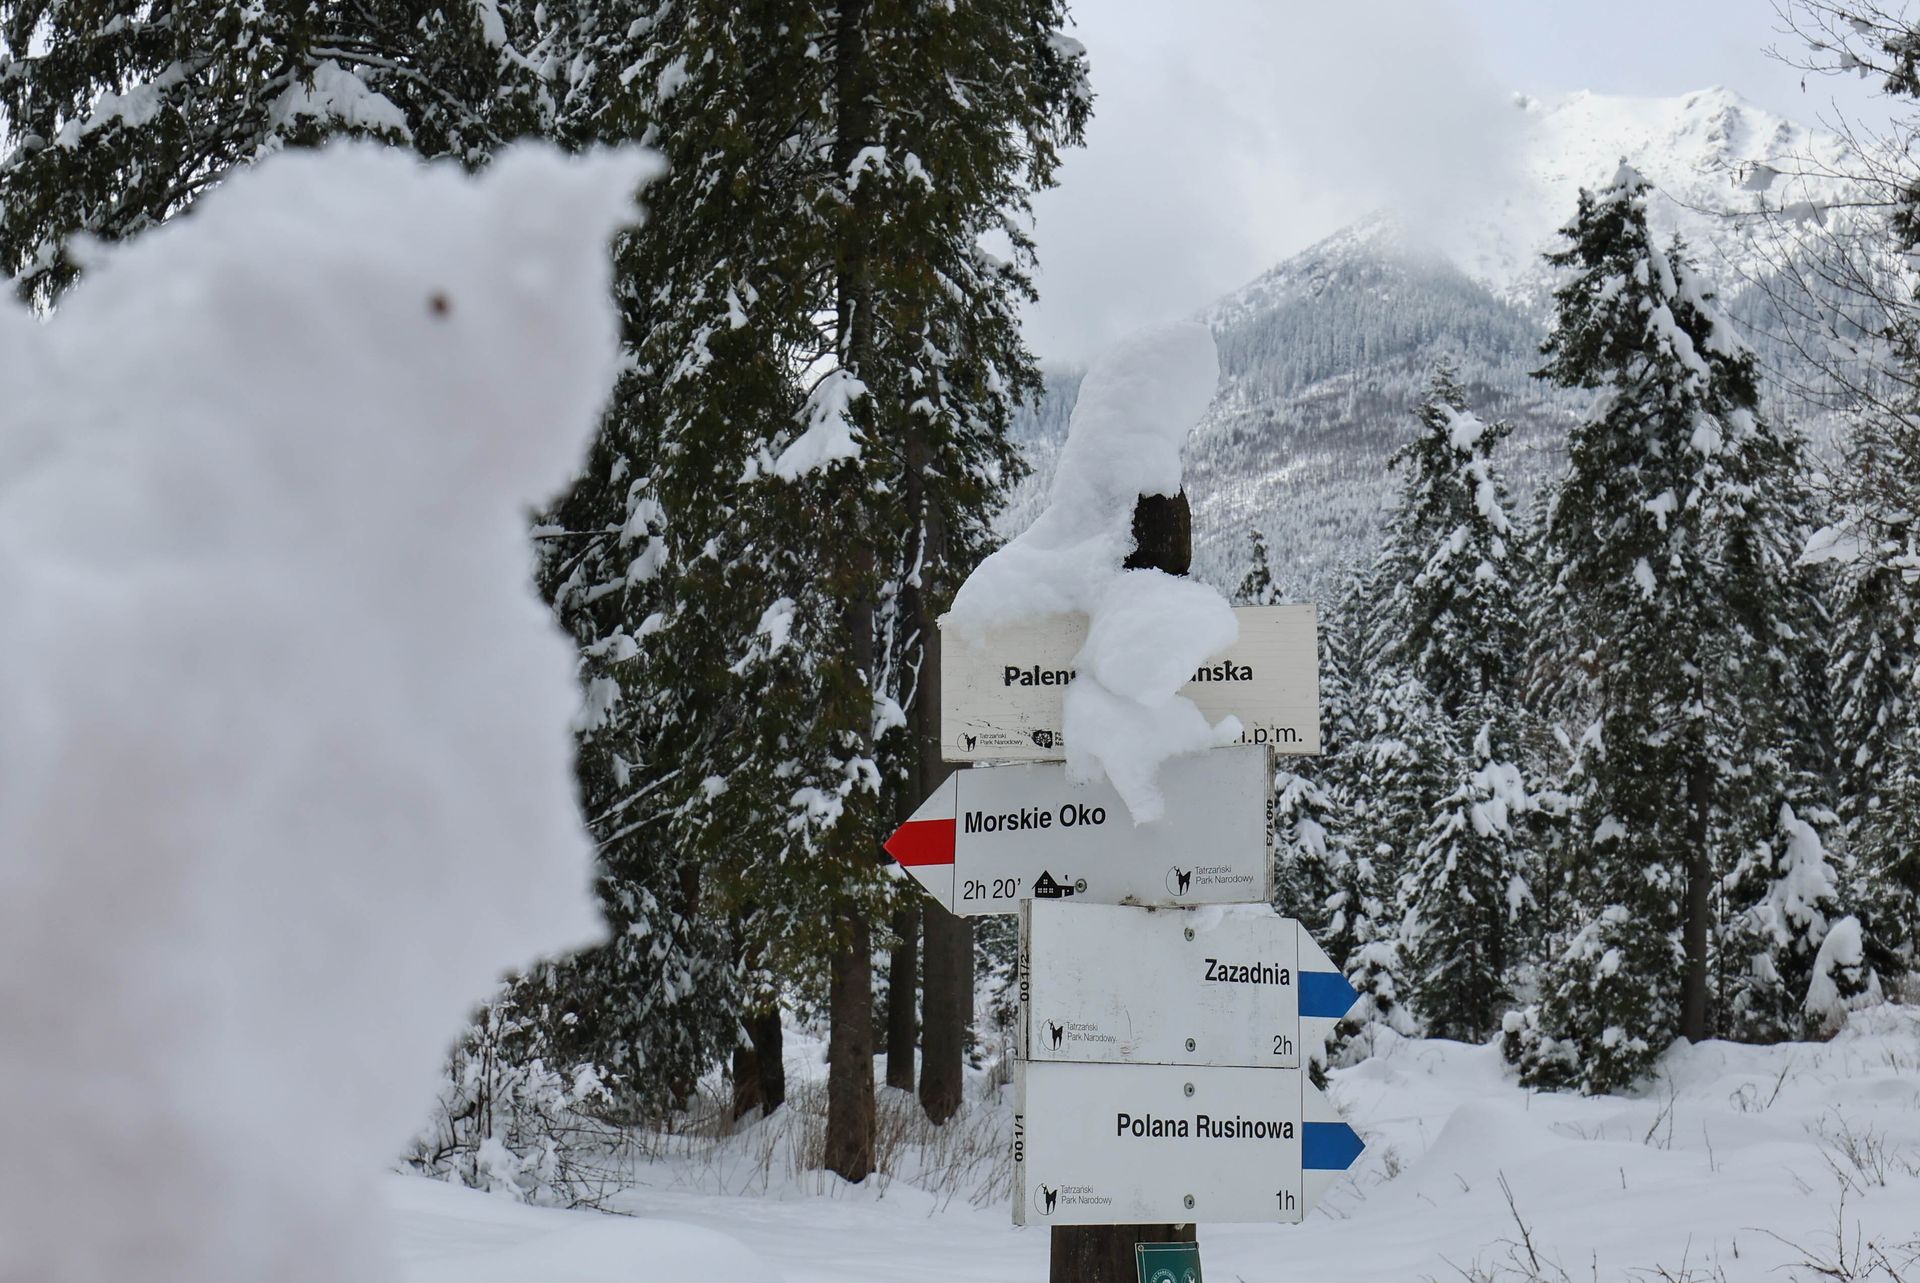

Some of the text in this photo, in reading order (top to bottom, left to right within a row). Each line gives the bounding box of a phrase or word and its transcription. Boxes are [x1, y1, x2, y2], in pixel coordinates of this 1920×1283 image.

[965, 804, 1106, 833] Morskie Oko
[1195, 864, 1232, 875] Tatrzański
[1196, 874, 1254, 885] Park Narodowy
[963, 880, 986, 900] 2h
[1020, 954, 1029, 1002] 001/2
[1204, 958, 1290, 985] Zazadnia
[1066, 1021, 1099, 1031] Tatrzański
[1067, 1031, 1117, 1044] Park Narodowy
[1273, 1035, 1293, 1055] 2h
[1117, 1113, 1294, 1139] Polana Rusinowa
[1014, 1114, 1024, 1162] 001/1
[1060, 1184, 1094, 1194] Tatrzański
[1061, 1195, 1113, 1206] Park Narodowy
[1275, 1189, 1295, 1210] 1h
